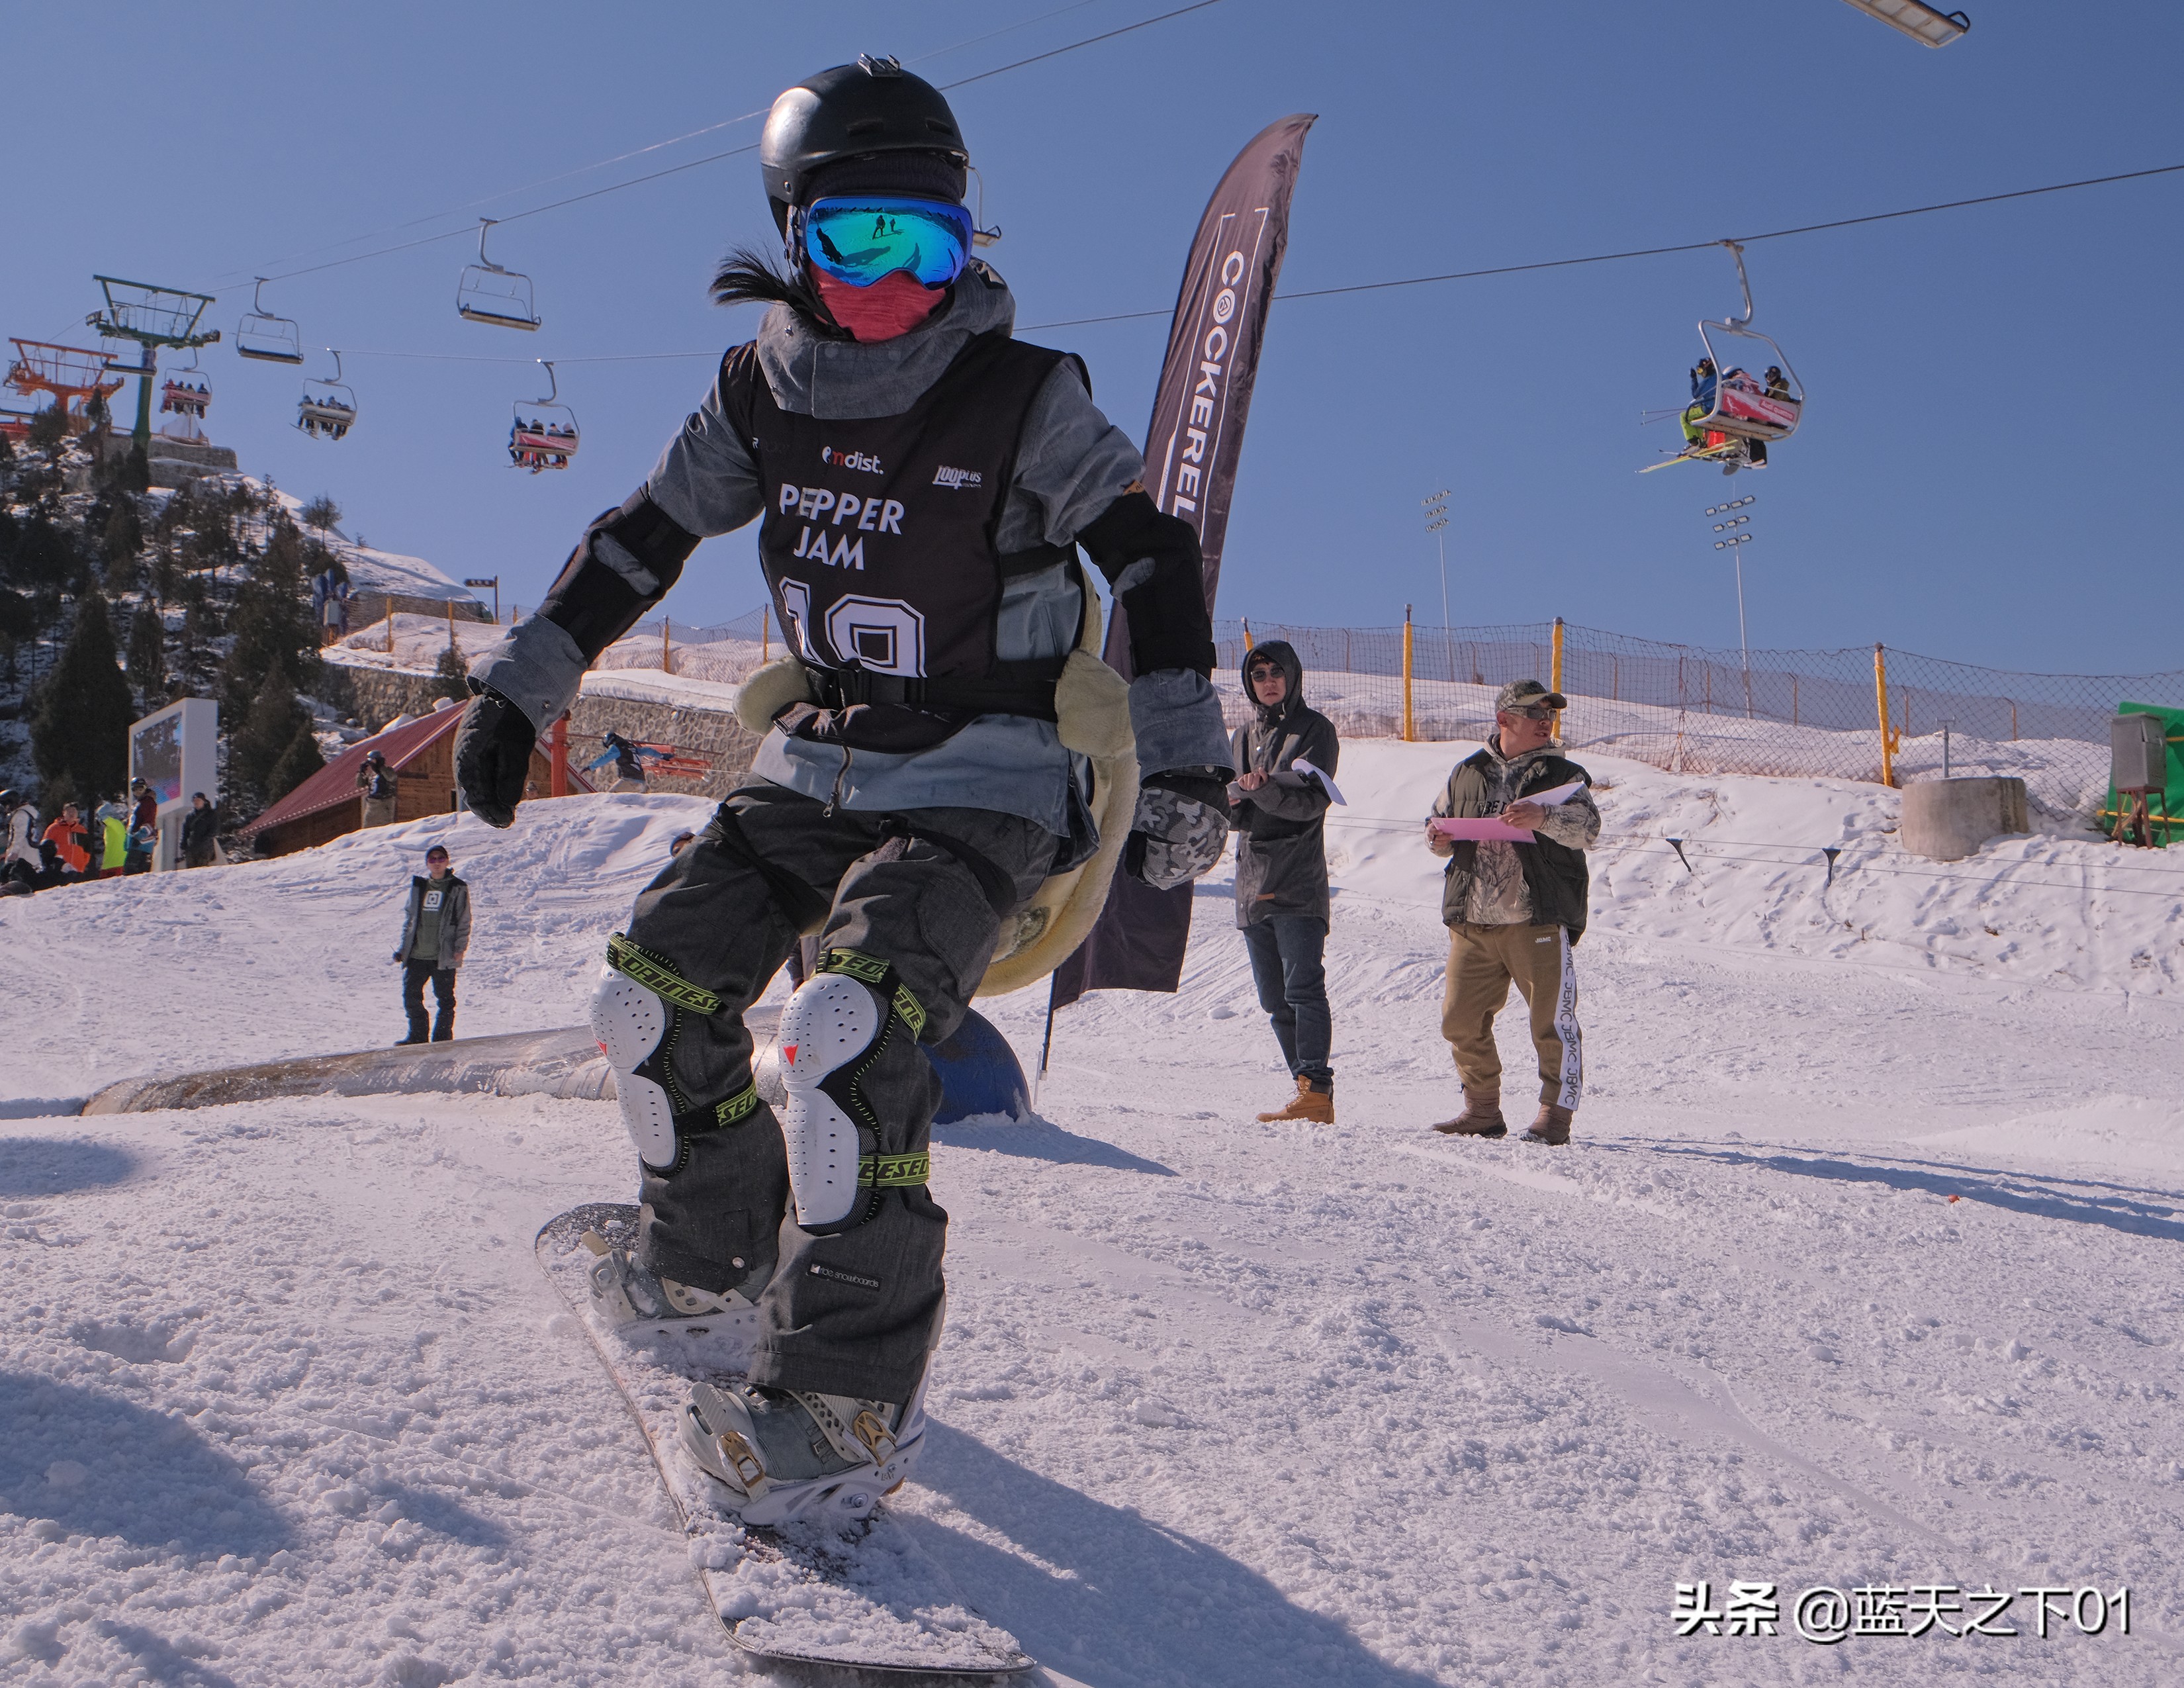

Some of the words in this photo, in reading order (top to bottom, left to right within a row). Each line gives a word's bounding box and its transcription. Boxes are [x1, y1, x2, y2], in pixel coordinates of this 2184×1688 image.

[780, 483, 905, 535] PEPPER
[794, 526, 864, 571] JAM
[1560, 982, 1572, 1022] JBMC
[1560, 1024, 1577, 1063] JBMC
[1564, 1067, 1578, 1105] JBMC
